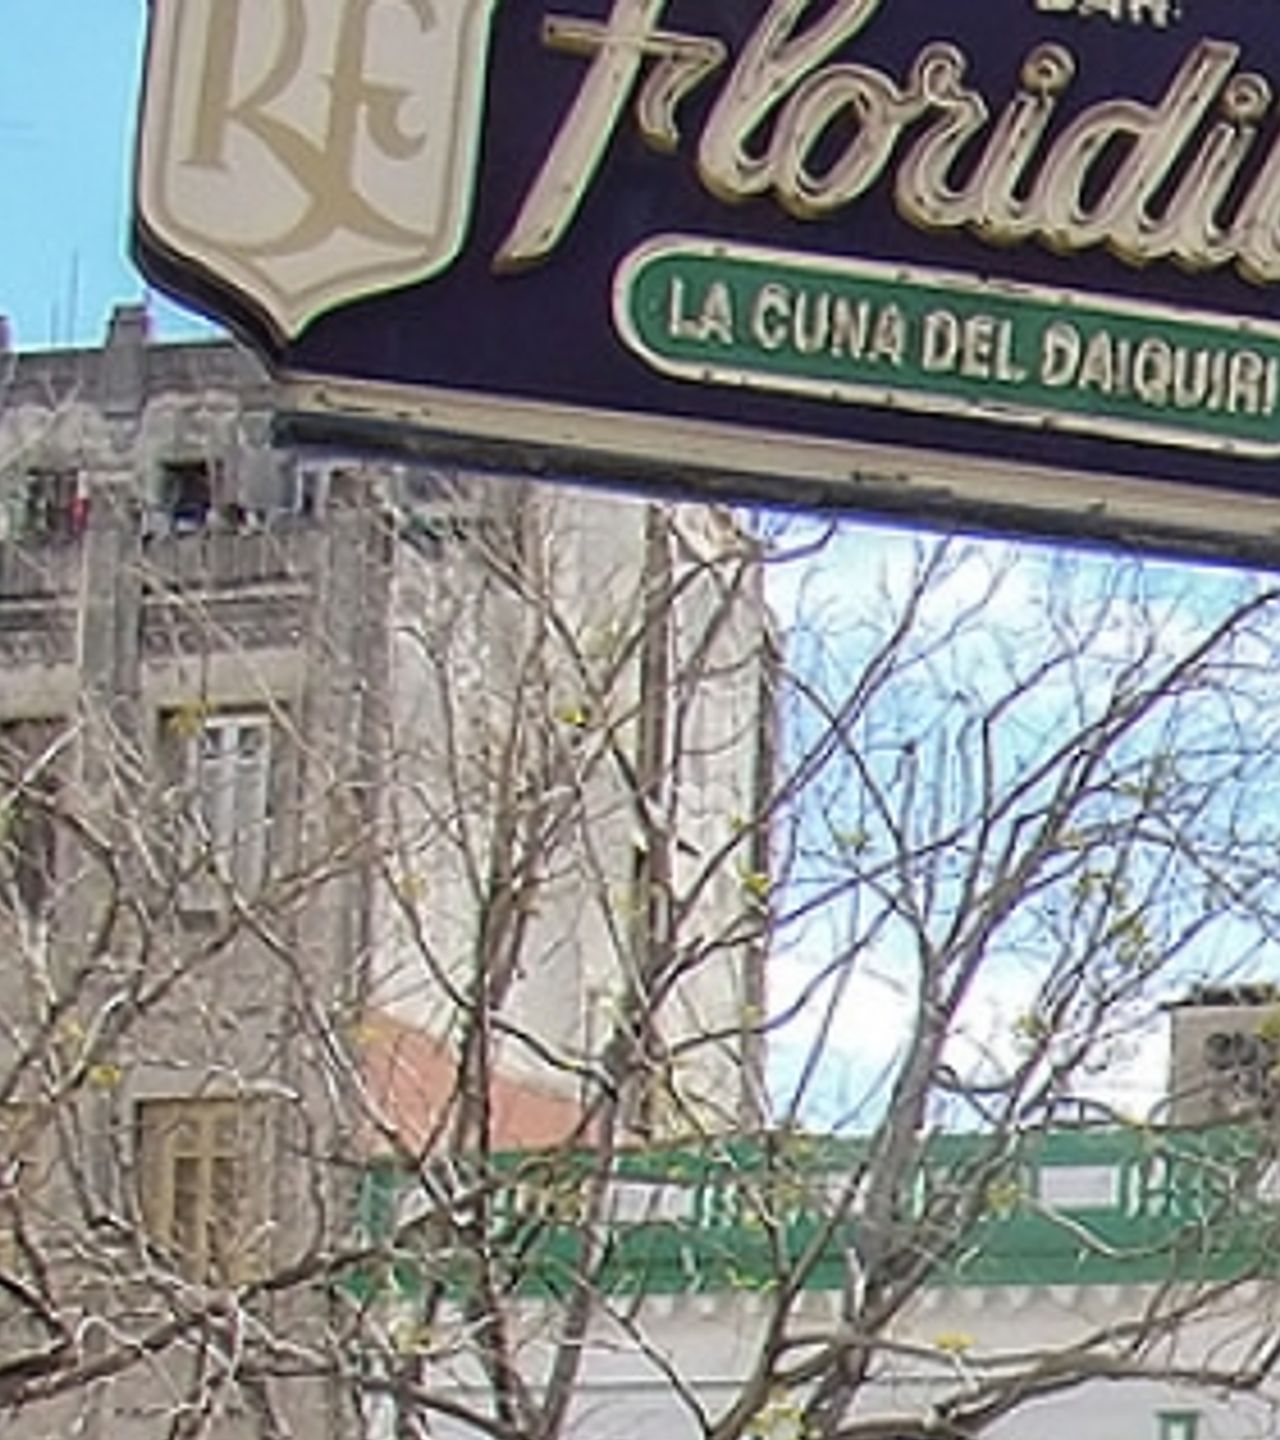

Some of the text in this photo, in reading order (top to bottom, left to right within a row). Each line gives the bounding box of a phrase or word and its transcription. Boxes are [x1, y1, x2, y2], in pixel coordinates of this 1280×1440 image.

[668, 275, 1280, 417] LA CUNA DEL DAIQUIRI
